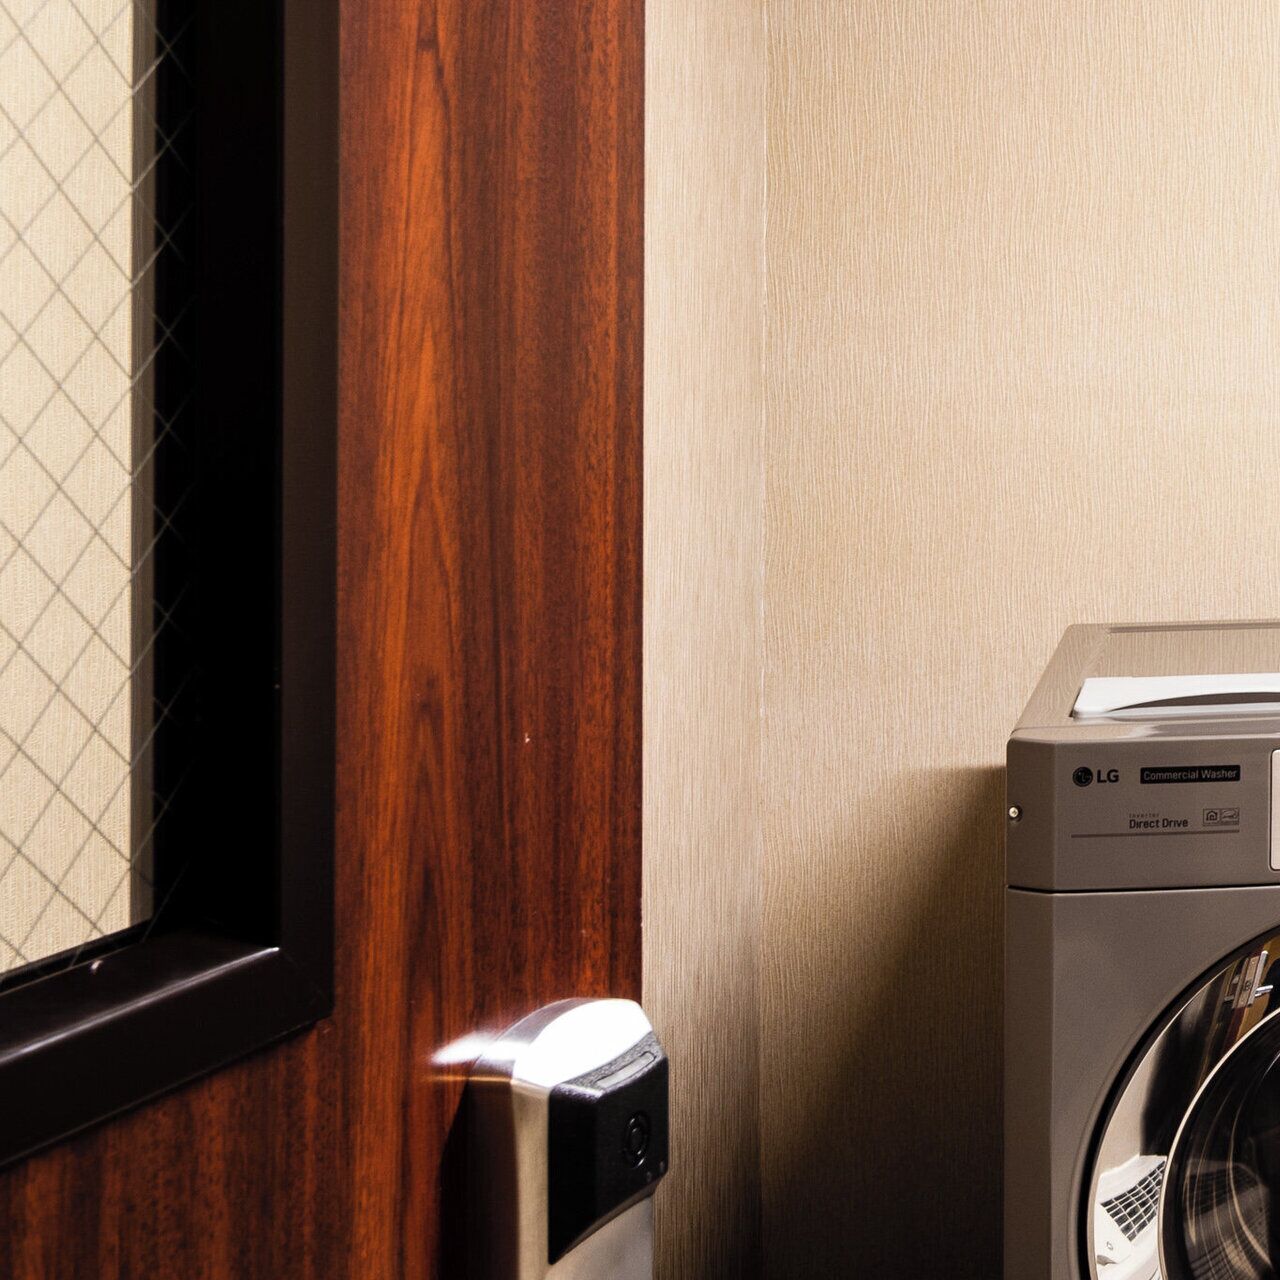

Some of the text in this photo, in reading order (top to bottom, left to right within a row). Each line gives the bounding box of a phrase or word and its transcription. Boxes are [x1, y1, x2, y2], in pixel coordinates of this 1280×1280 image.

[1097, 769, 1120, 783] LG
[1143, 767, 1238, 781] Commercial Washer
[1129, 818, 1189, 829] Direct Drive
